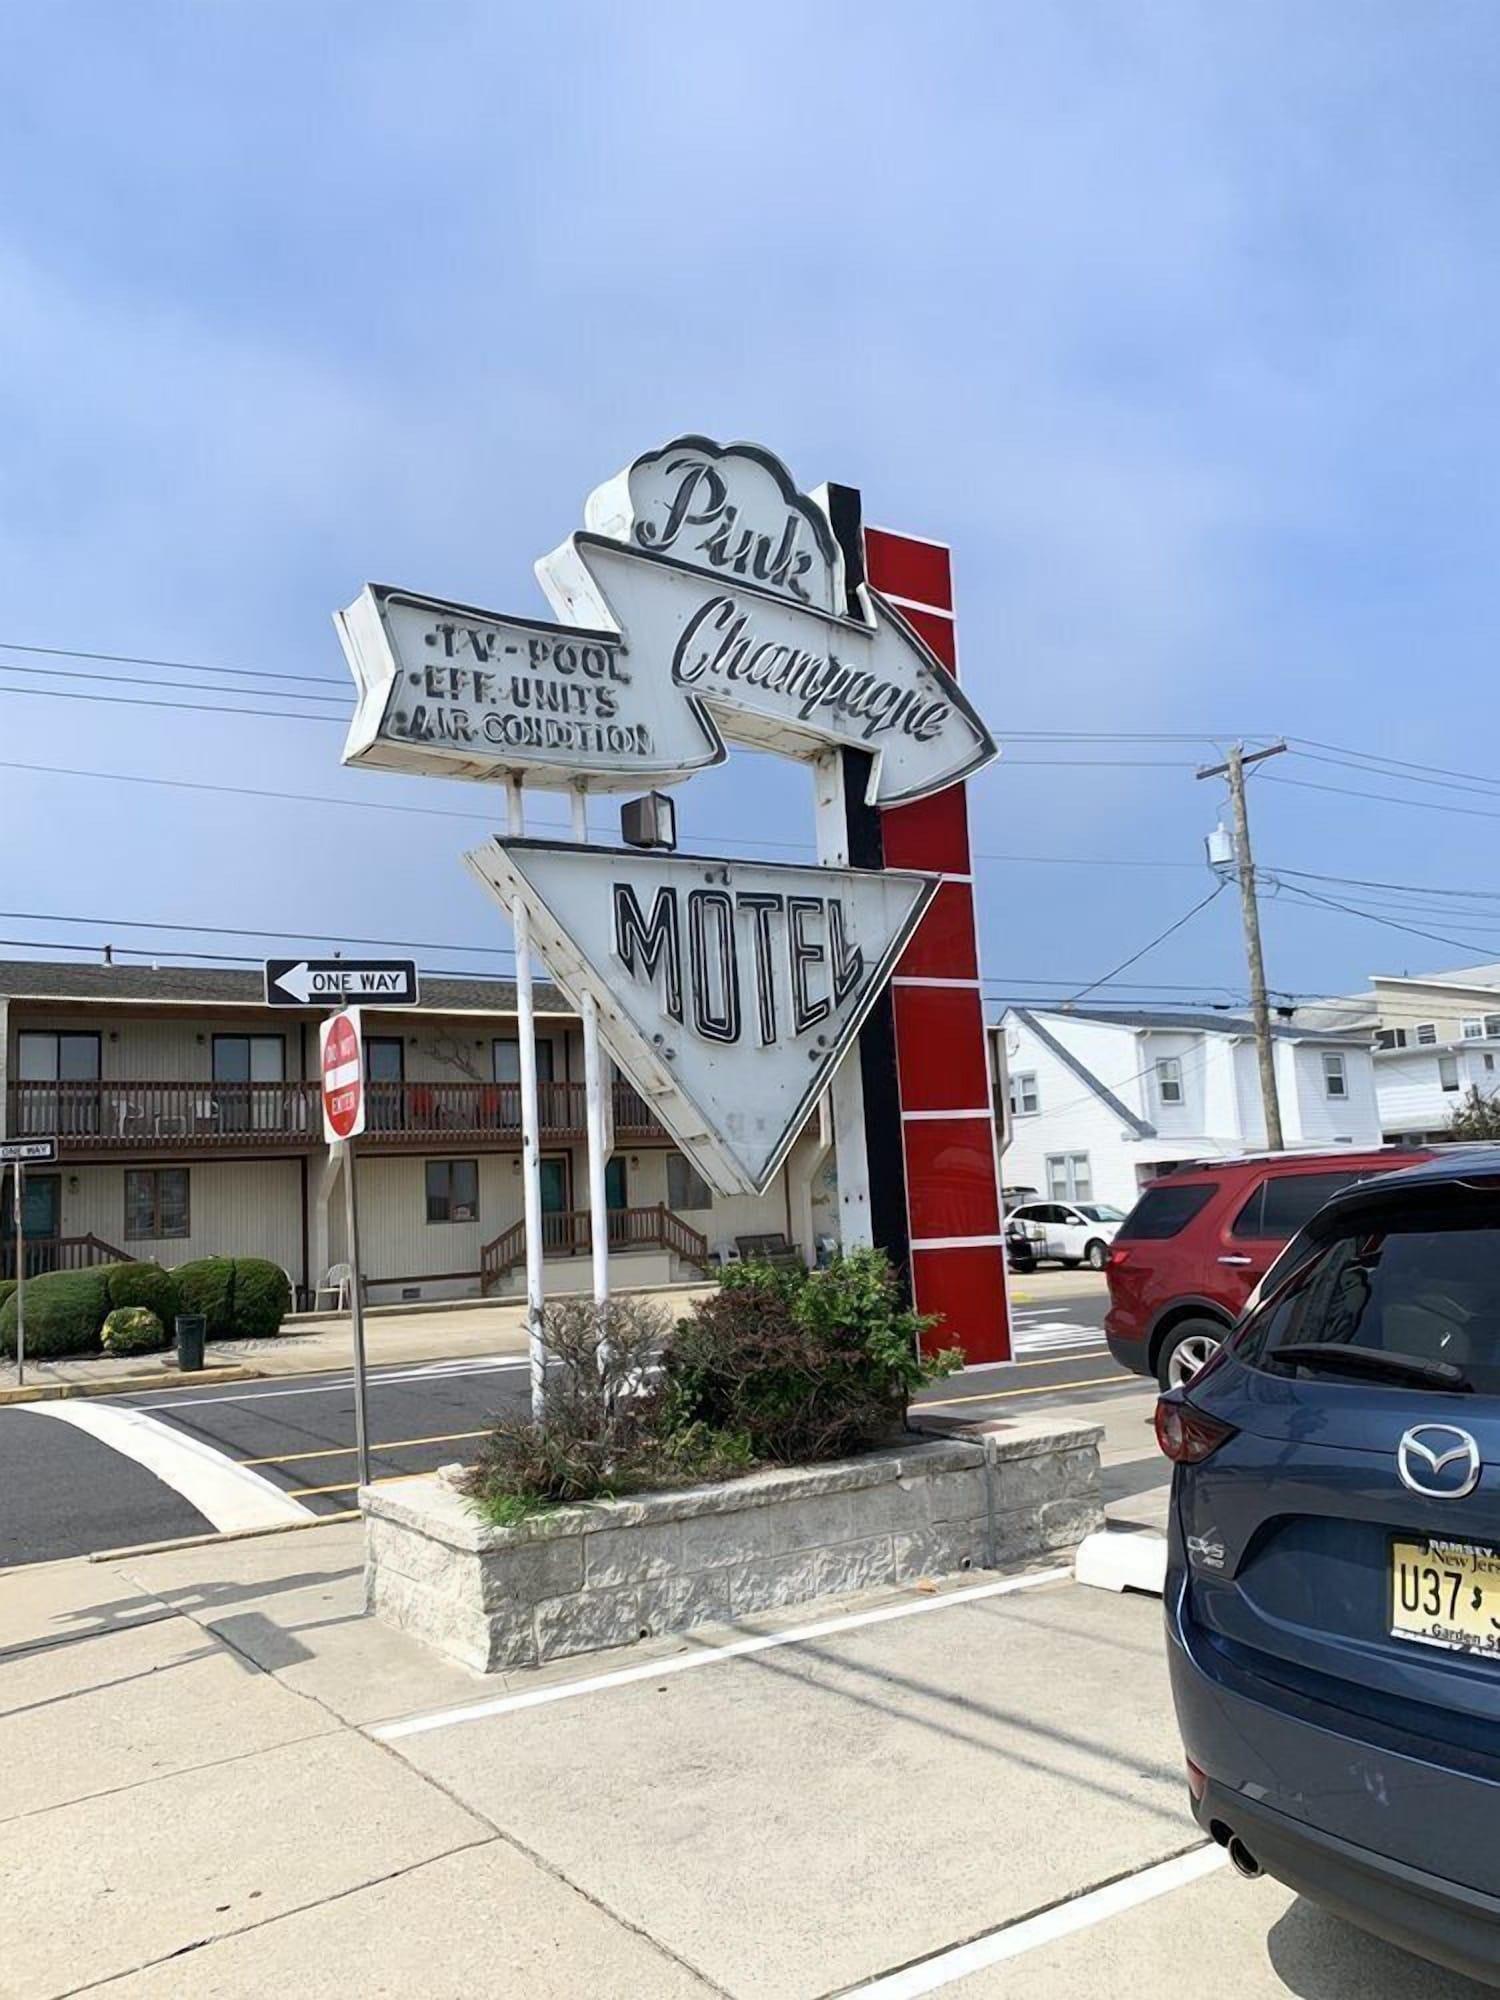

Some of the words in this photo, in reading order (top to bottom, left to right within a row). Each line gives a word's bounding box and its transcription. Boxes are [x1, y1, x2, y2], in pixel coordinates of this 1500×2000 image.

[634, 457, 814, 605] Pink
[671, 596, 950, 742] Champagne
[511, 675, 620, 719] UNITS
[312, 973, 353, 991] ONE
[360, 973, 401, 991] WAY
[611, 882, 865, 1048] MOTEL
[1431, 1547, 1469, 1567] New
[1401, 1563, 1462, 1620] U37
[1432, 1623, 1480, 1645] Garden
